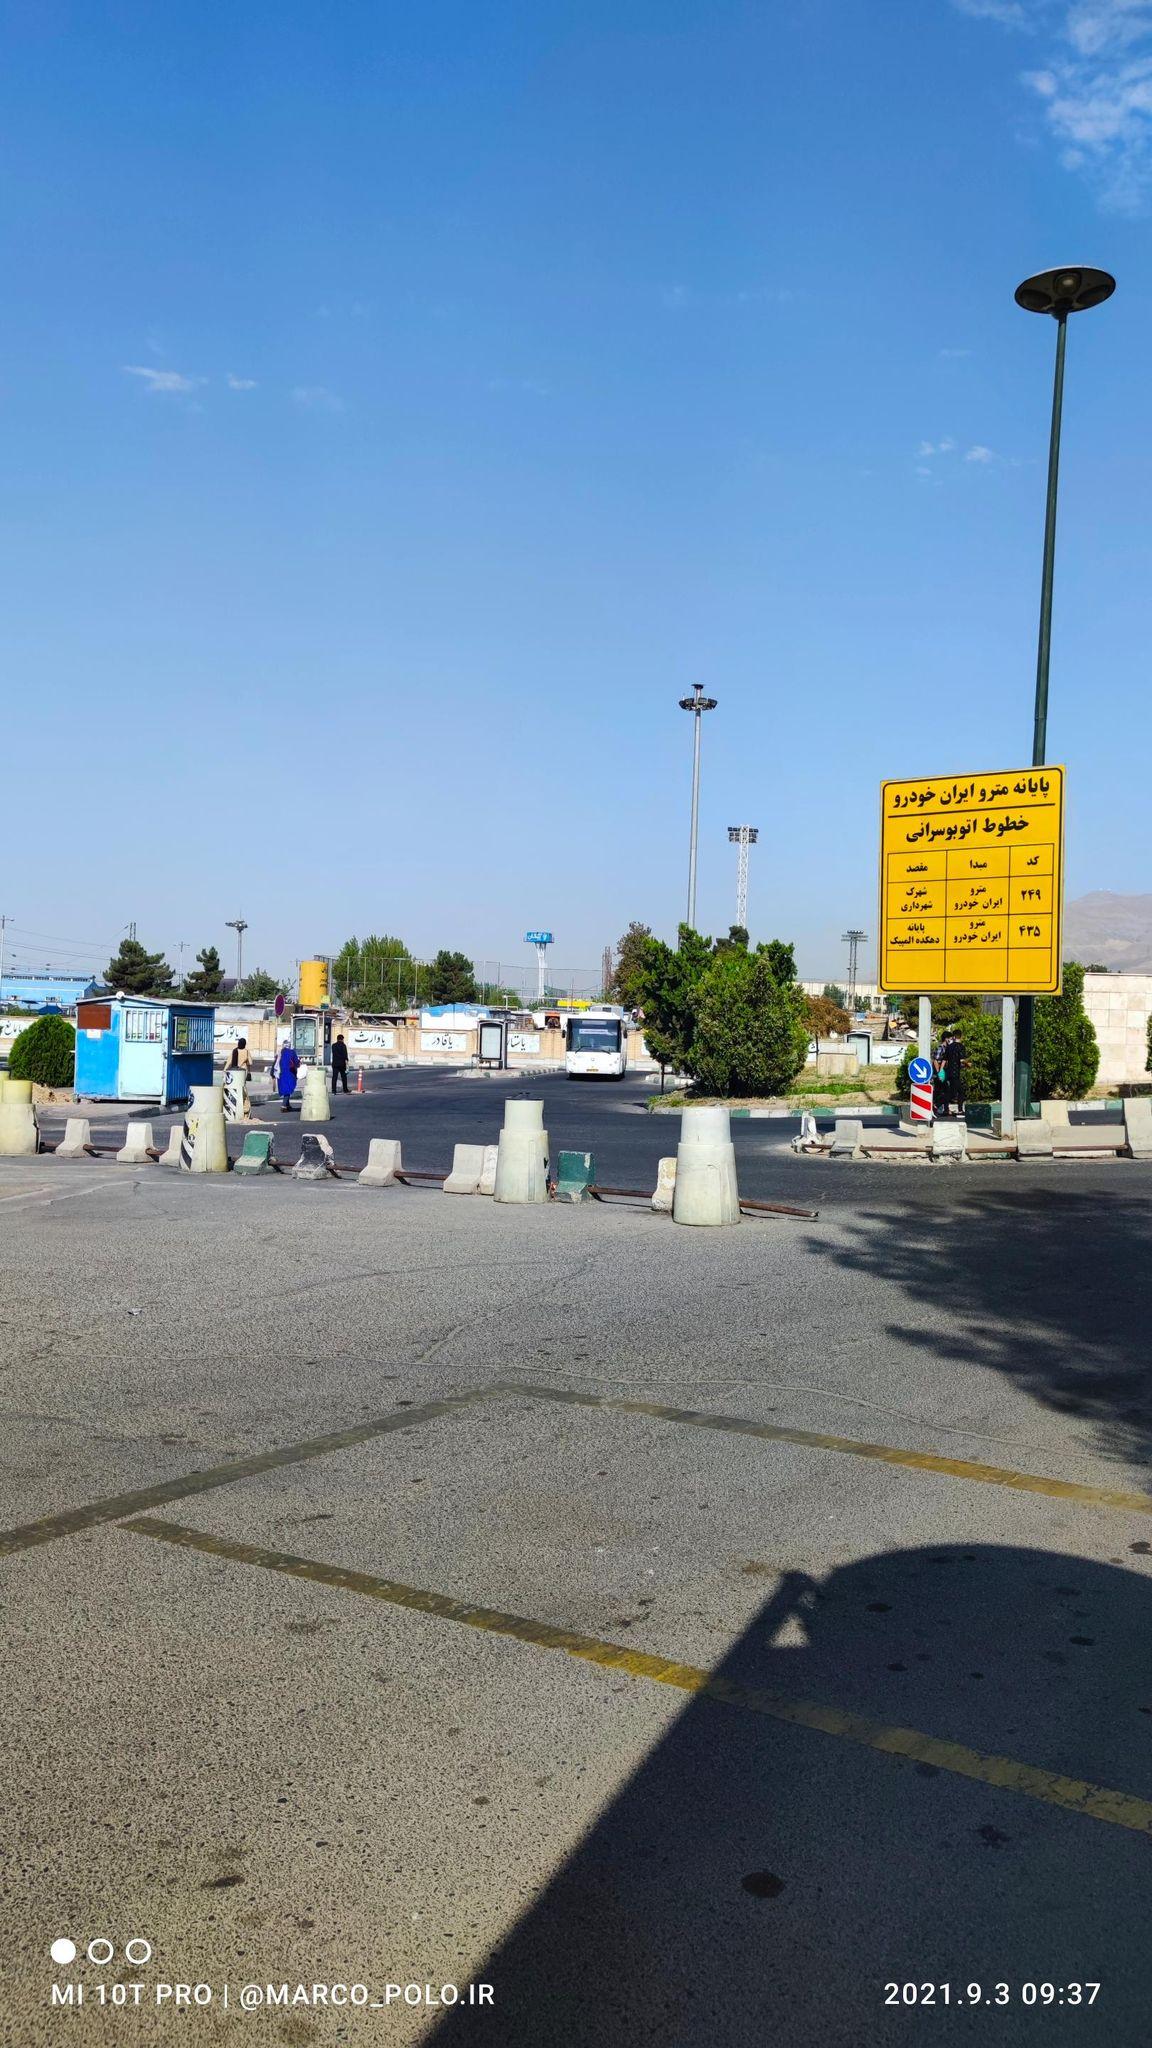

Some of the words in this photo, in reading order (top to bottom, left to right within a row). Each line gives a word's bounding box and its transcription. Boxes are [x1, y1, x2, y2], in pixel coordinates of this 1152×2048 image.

[978, 784, 1009, 802] مترو
[1013, 776, 1050, 798] پایانه
[893, 787, 936, 808] خودرو
[940, 783, 975, 805] ایران
[906, 818, 977, 842] اتوبوسرانی
[982, 815, 1029, 837] خطوط
[969, 859, 988, 871] مبدا
[1026, 855, 1040, 866] کد
[906, 862, 928, 873] مقصد
[906, 886, 927, 899] شهرک
[970, 885, 987, 896] مترو
[1021, 889, 1041, 901] ۲۴۹
[901, 901, 933, 912] شهرداری
[954, 898, 979, 911] خودرو
[982, 898, 1003, 909] ایران
[907, 923, 925, 934] پایانه
[969, 919, 986, 930] مترو
[953, 931, 978, 944] خودرو
[980, 931, 1002, 943] ایران
[1019, 925, 1040, 938] ۴۳۵
[890, 935, 914, 947] المپیک
[915, 935, 940, 944] دهکده
[354, 1031, 381, 1043] وارث
[431, 1034, 449, 1046] قادر
